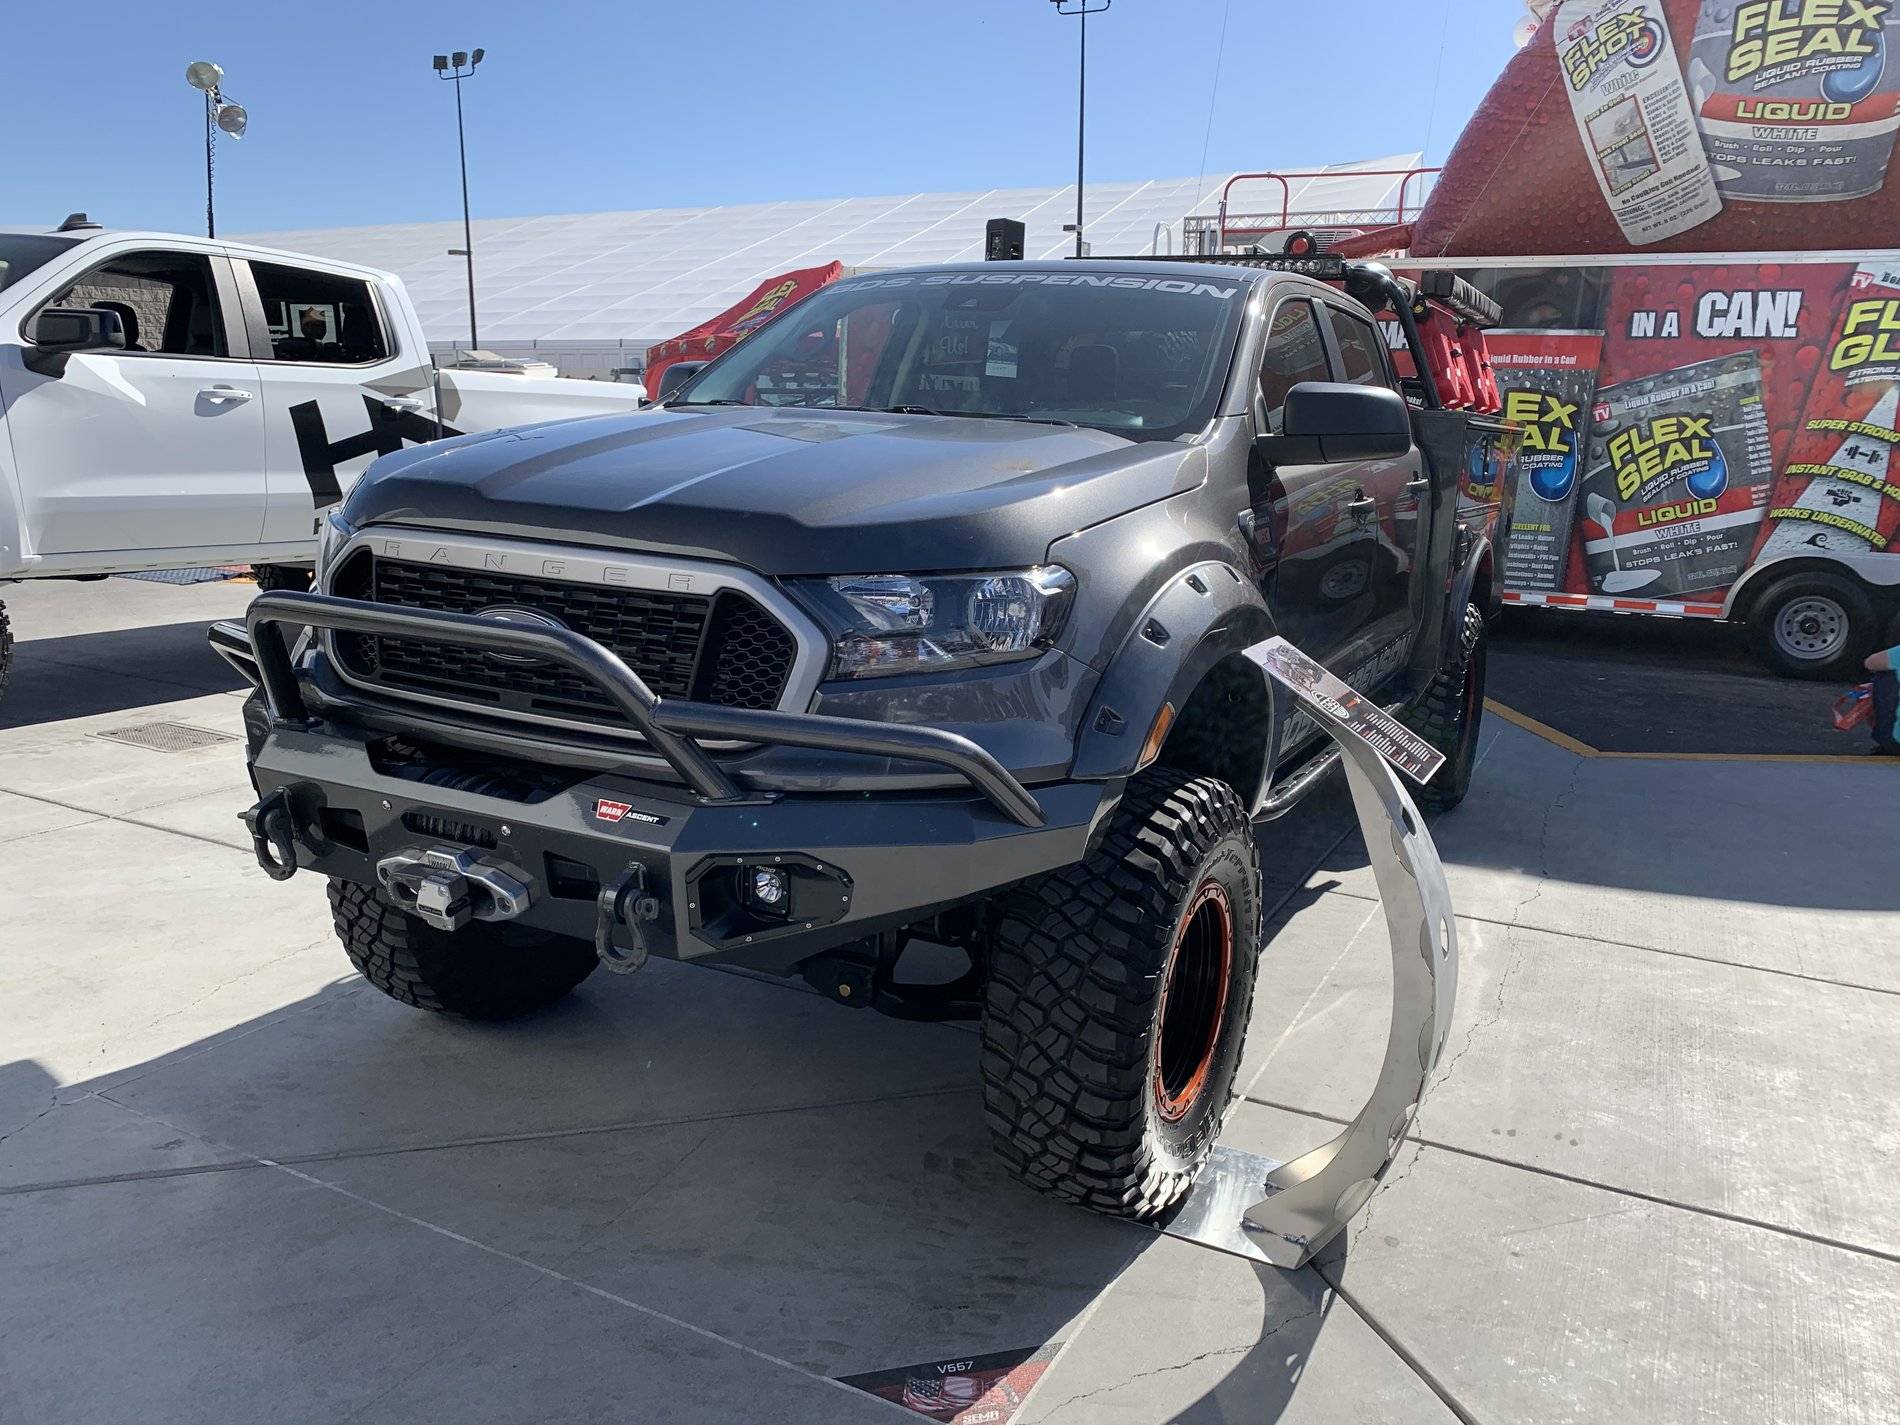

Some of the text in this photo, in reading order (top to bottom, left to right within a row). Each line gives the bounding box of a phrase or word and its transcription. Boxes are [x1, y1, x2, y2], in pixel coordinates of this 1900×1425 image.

[1736, 0, 1890, 43] FLEX
[1563, 6, 1646, 74] FLEX
[1570, 22, 1646, 90] SHOT
[1729, 28, 1874, 81] SEAL
[1753, 63, 1861, 90] SEALANT COATING
[1756, 56, 1863, 81] LIQUID RUBBER
[1601, 70, 1640, 96] White
[1737, 101, 1853, 120] LIQUID
[1753, 126, 1818, 140] WHITE
[1708, 152, 1857, 166] TOPS LEAKS FAST!
[1714, 140, 1843, 154] Brush Roll Dip Pour
[920, 274, 1239, 300] SUSPENSION
[1631, 291, 1803, 337] IN A CAN!
[1843, 300, 1900, 335] FL
[1513, 354, 1544, 363] Rubber
[1830, 332, 1900, 370] GL
[1507, 392, 1578, 429] EX
[1625, 397, 1650, 410] Liquid
[1650, 389, 1680, 402] Rubber
[1593, 407, 1611, 421] TV
[1523, 425, 1569, 452] AL
[1609, 416, 1711, 470] FLEX
[1806, 419, 1900, 443] SUPER STRONG
[1522, 461, 1563, 469] COATING
[1617, 438, 1713, 500] SEAL
[1641, 460, 1708, 496] LIQUID RUBBER
[1785, 464, 1838, 475] INSTANT
[1837, 469, 1873, 485] GRAB
[1872, 480, 1884, 489] &
[1642, 465, 1709, 502] SEALANT COATING
[1637, 498, 1718, 526] LIQUID
[1770, 508, 1811, 519] WORKS
[1655, 522, 1701, 539] WHITE
[1626, 542, 1738, 568] STOPS LEAKS FAST!
[1633, 533, 1723, 556] Brush Roll Dip Pour
[383, 540, 696, 592] RANGER
[600, 805, 660, 823] WARN ASCENT
[756, 865, 776, 873] RIGID
[937, 1361, 974, 1374] V557
